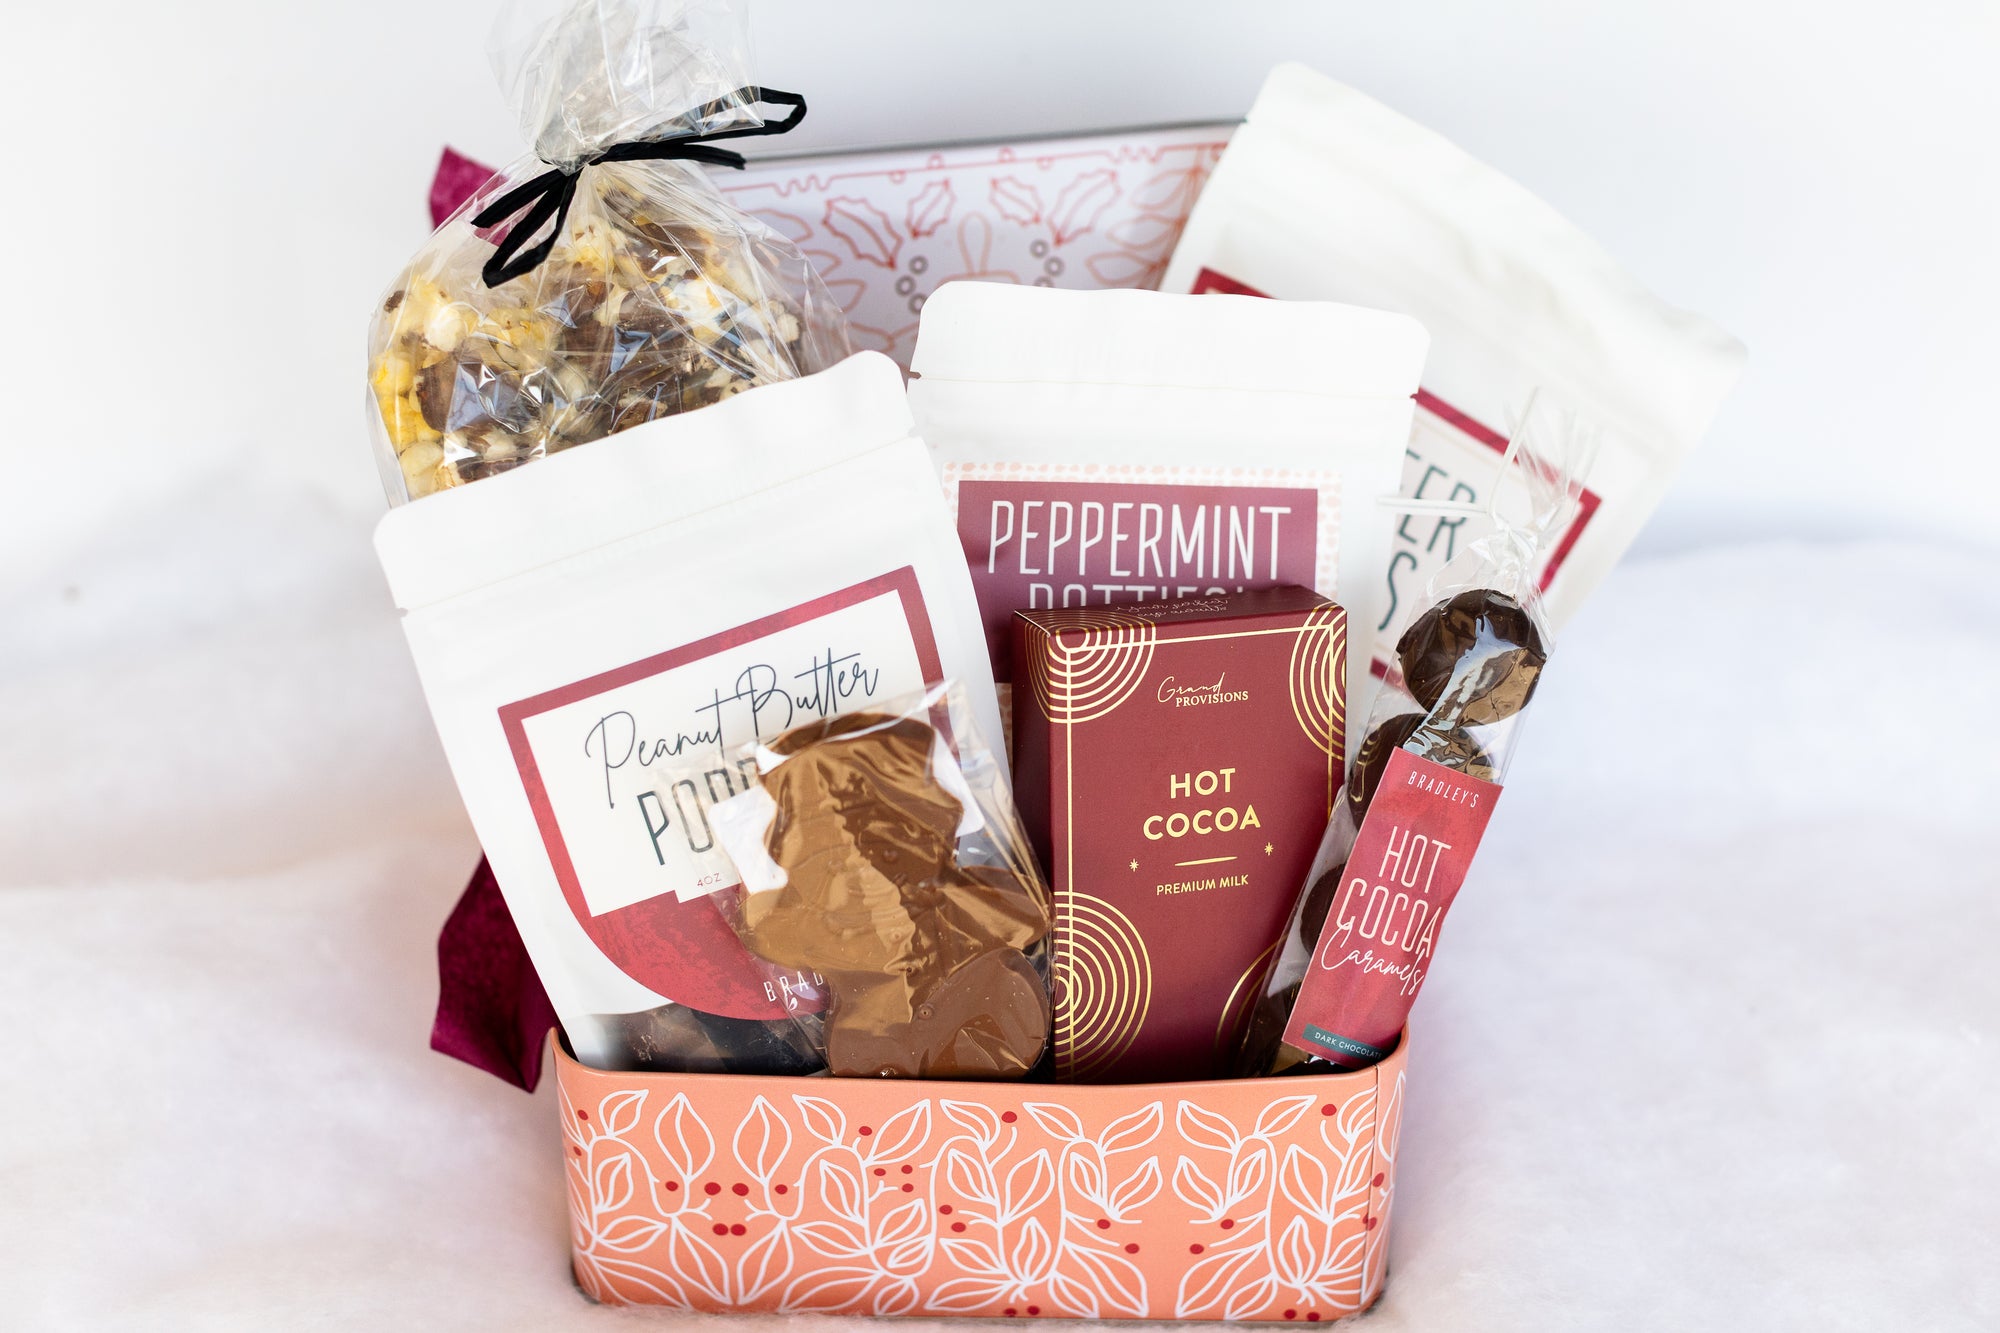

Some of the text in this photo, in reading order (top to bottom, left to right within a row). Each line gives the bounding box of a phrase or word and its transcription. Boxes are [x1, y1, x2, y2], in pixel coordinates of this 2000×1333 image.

[988, 500, 1292, 580] PEPPERMINT
[1157, 672, 1226, 703] Grand
[1175, 691, 1249, 707] PROVISIONS
[584, 648, 879, 809] Peanut Butter
[1170, 767, 1236, 799] HOT
[1407, 771, 1480, 808] BRADLEY'S
[1143, 804, 1261, 840] COCOA
[1378, 826, 1452, 894] HOT
[1156, 874, 1249, 896] PREMIUM MILK
[1336, 878, 1442, 958] COCOA
[1321, 921, 1425, 996] Caramels
[1314, 1031, 1337, 1046] DARK
